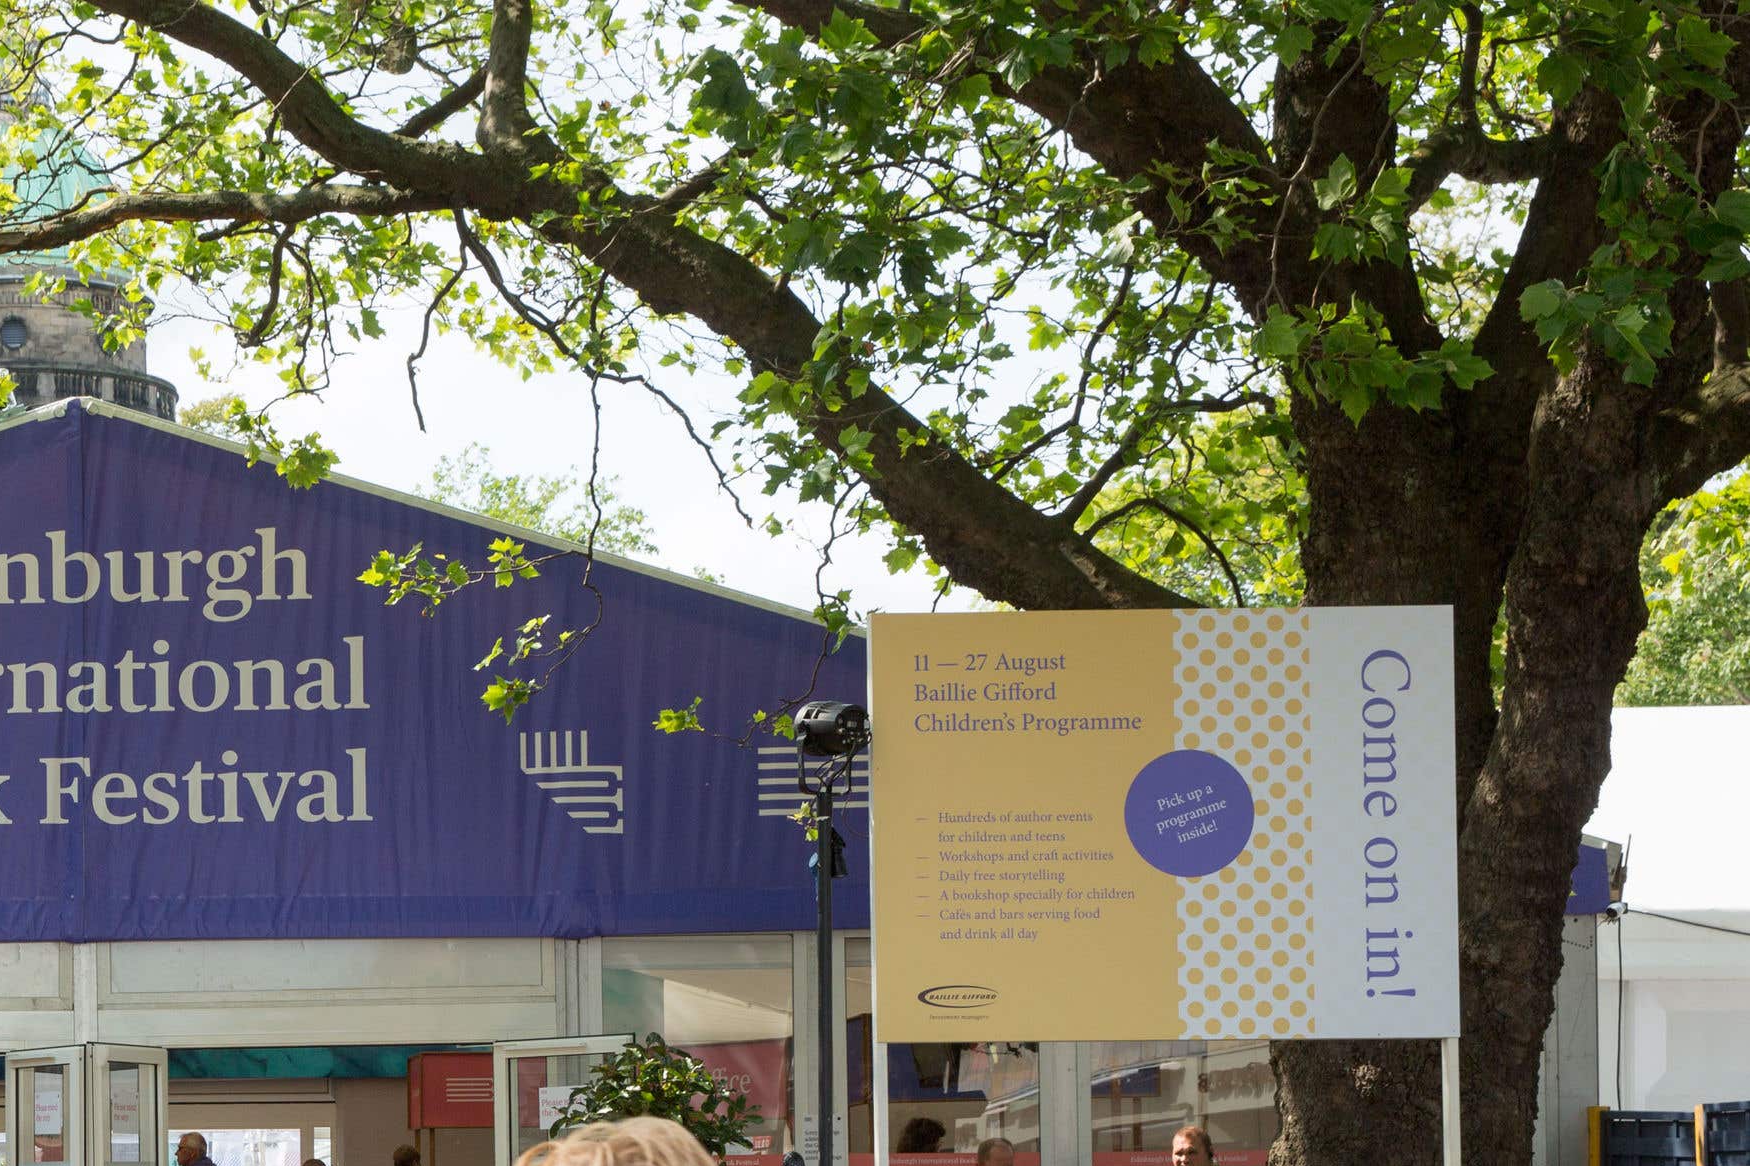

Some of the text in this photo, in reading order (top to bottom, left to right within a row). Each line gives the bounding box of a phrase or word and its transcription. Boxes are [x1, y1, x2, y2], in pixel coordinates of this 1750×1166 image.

[914, 653, 1066, 676] 11 27 August
[915, 682, 1057, 701] Baillie Gifford
[914, 712, 1142, 736] Children’s Programme
[39, 748, 373, 824] Festival
[1157, 785, 1213, 810] Pick up a
[938, 812, 1093, 824] Hundreds of author events
[1156, 800, 1226, 834] programme
[1361, 650, 1416, 998] Come on in!
[938, 831, 1066, 842] for children and teens
[1178, 820, 1218, 843] inside!
[938, 850, 1114, 864] Workshops and craft activities
[939, 869, 1065, 884] Daily free storytelling
[940, 888, 1135, 903] A bookshop specially for children
[939, 908, 1100, 922] Cafés and bars serving food
[940, 928, 1038, 942] and drink all day
